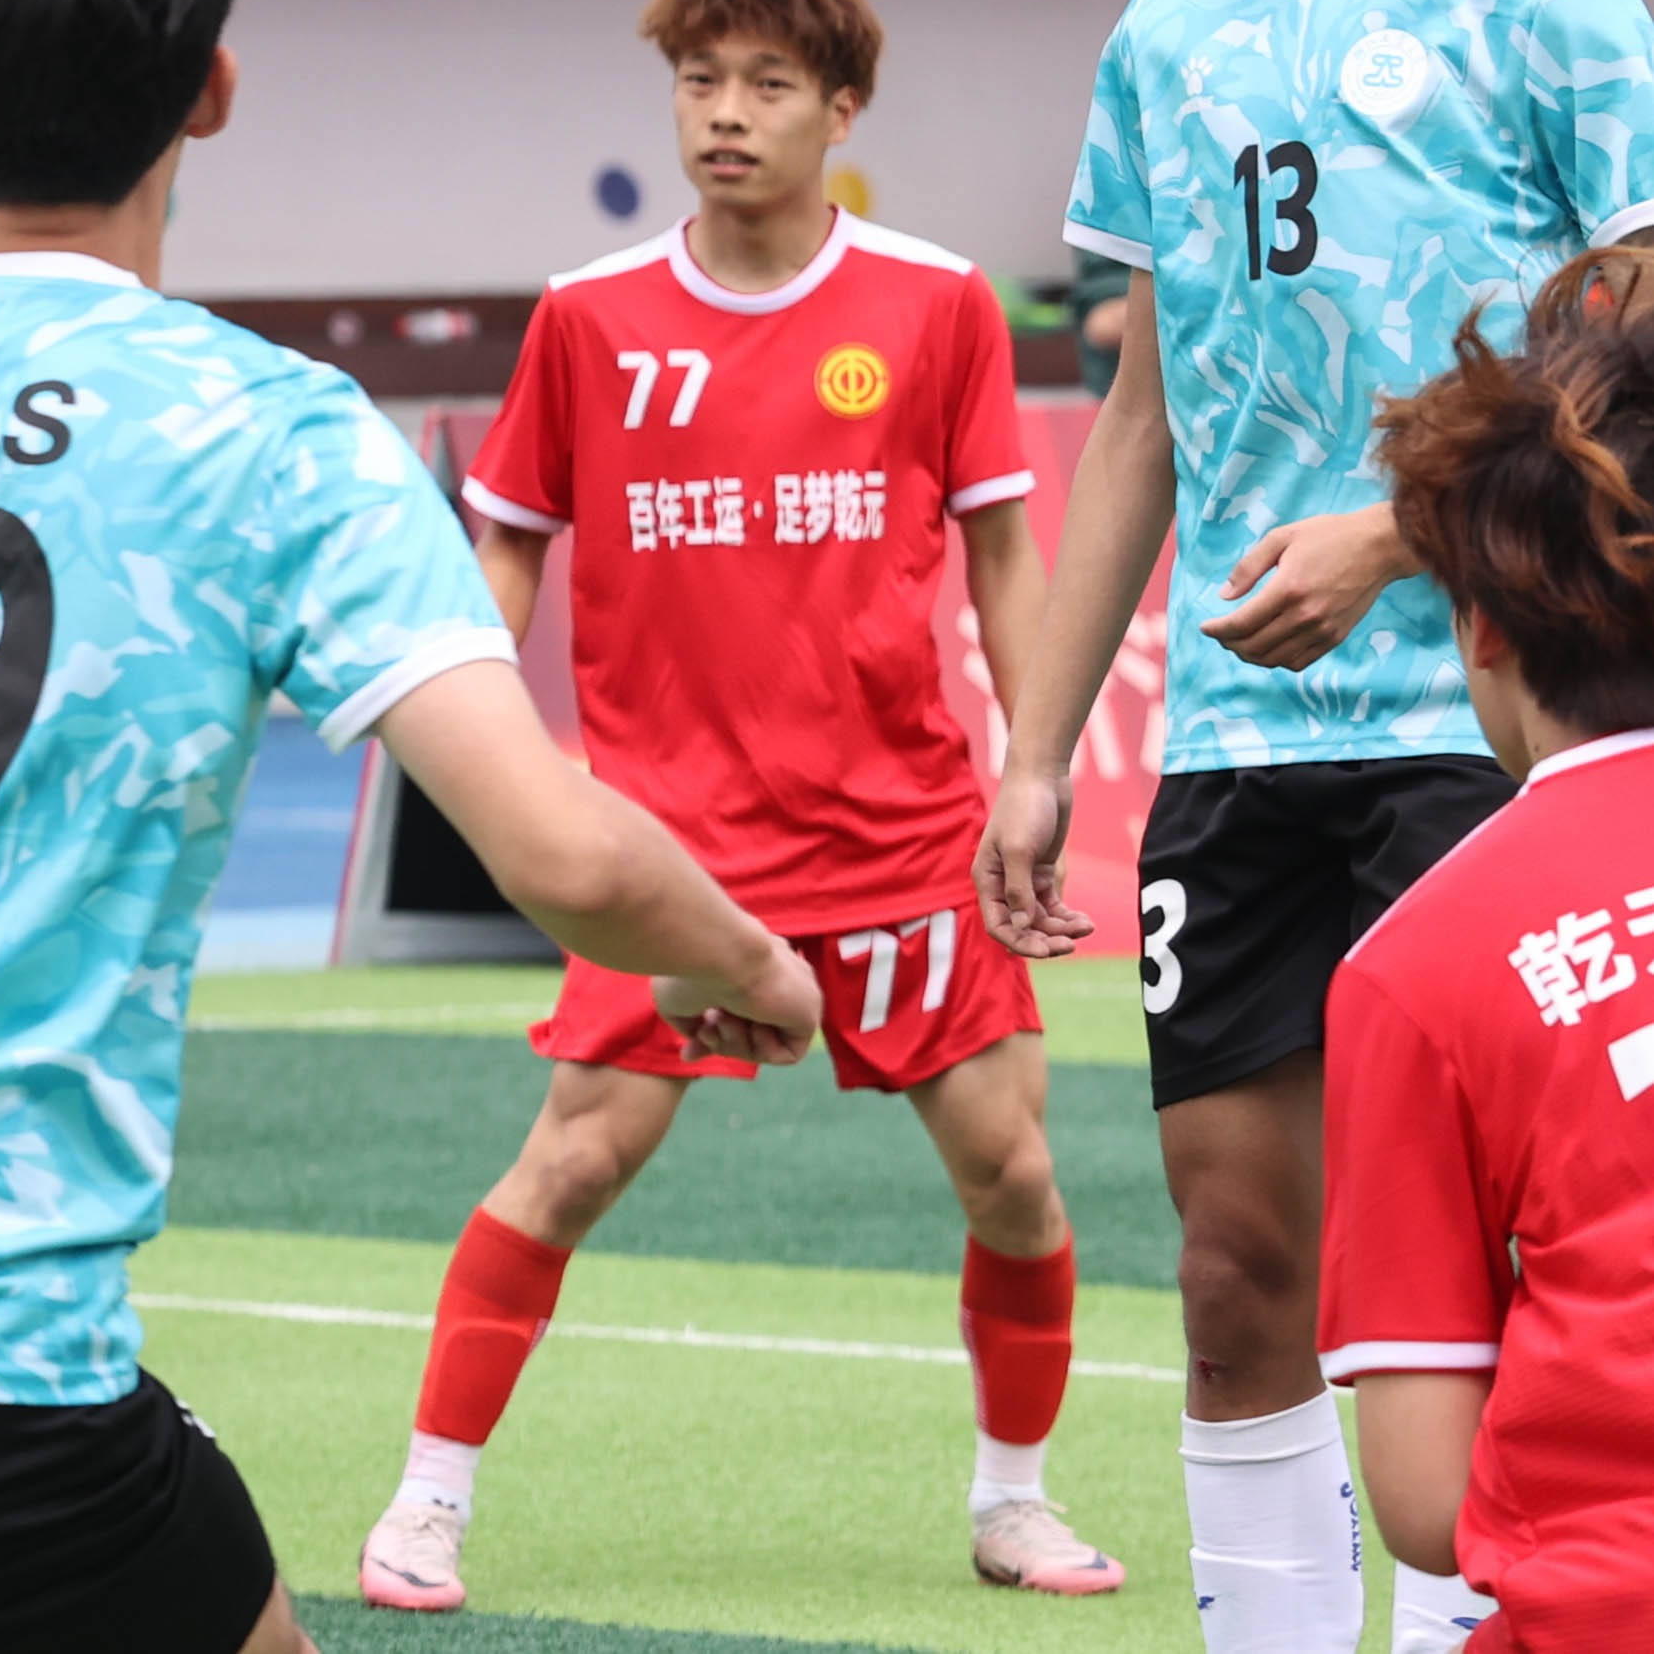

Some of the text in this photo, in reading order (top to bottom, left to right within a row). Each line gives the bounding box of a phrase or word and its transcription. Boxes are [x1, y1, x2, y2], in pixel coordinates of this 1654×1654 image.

[1233, 140, 1319, 281] 13
[617, 349, 712, 429] 77
[837, 908, 957, 1034] 77
